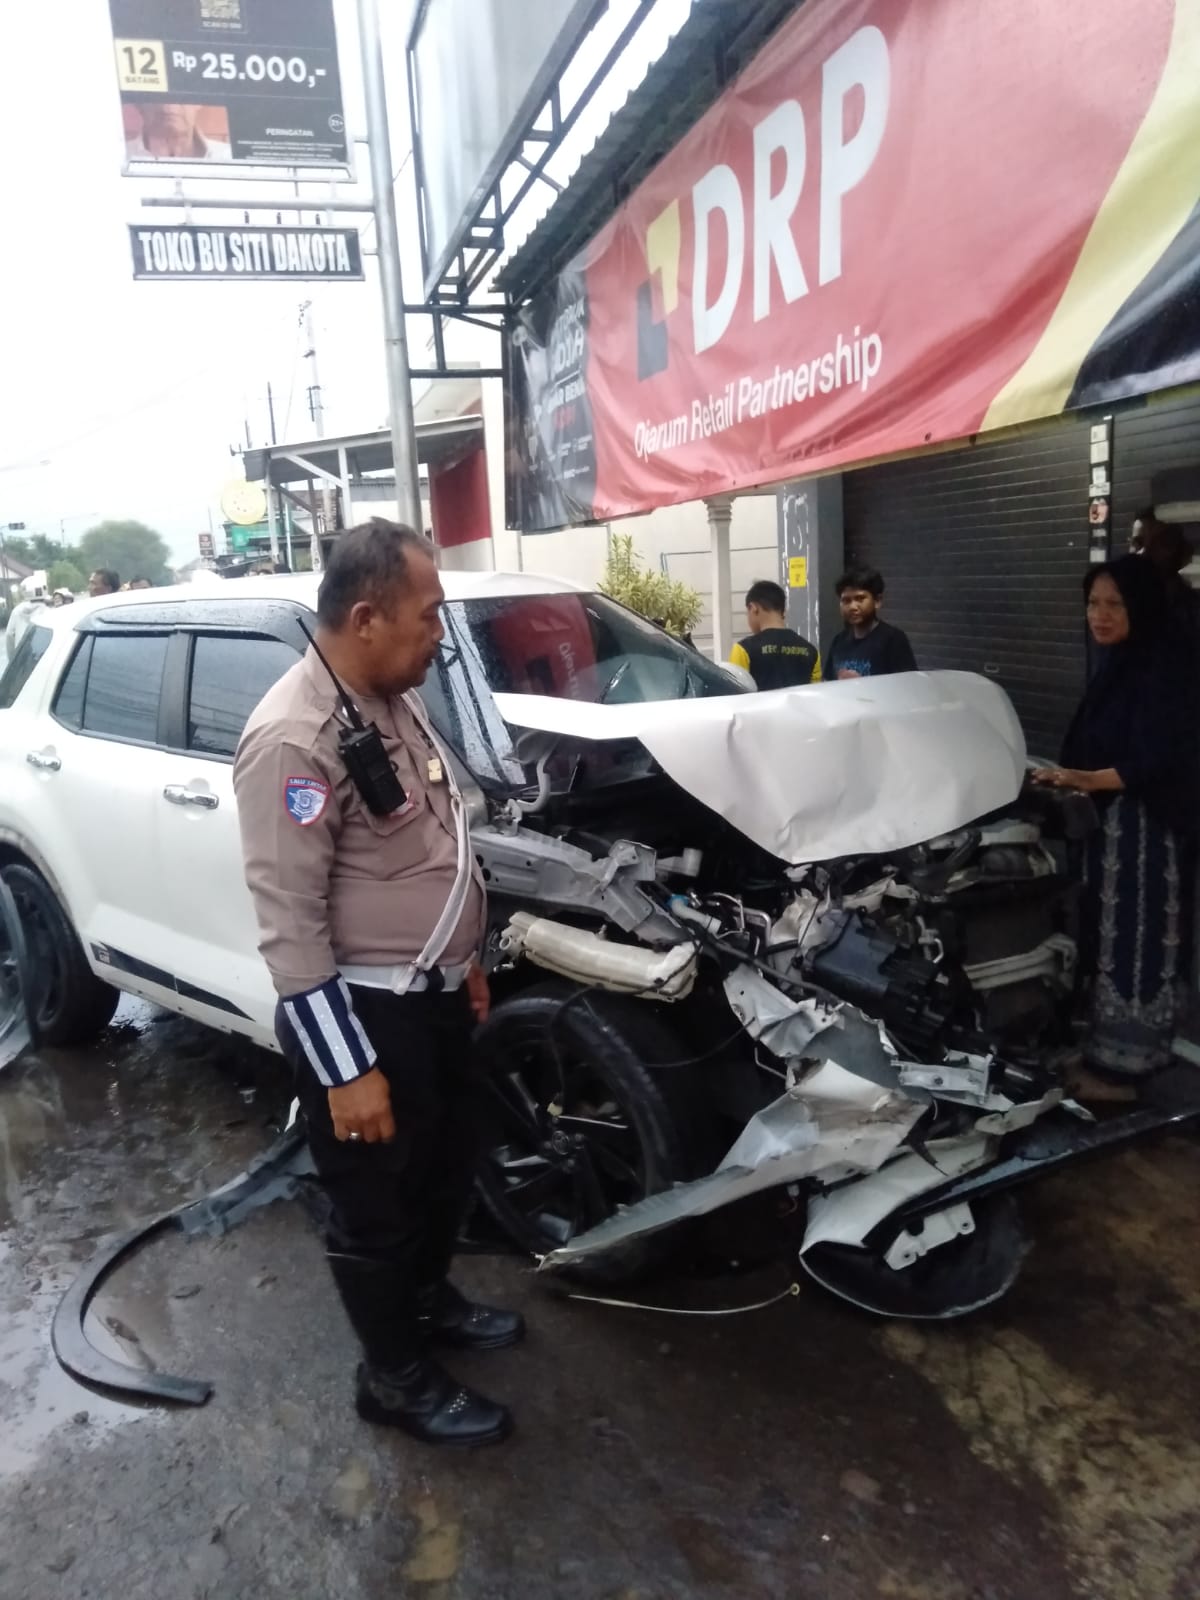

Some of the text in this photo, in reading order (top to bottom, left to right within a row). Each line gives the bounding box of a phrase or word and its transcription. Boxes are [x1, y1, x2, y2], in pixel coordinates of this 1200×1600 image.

[122, 46, 158, 75] 12
[172, 51, 326, 88] Rp 25.000,-
[692, 25, 891, 355] DRP
[138, 231, 351, 272] TOKO BU SITI DAKOTA
[690, 382, 735, 441] Retail
[738, 325, 883, 425] Partnership
